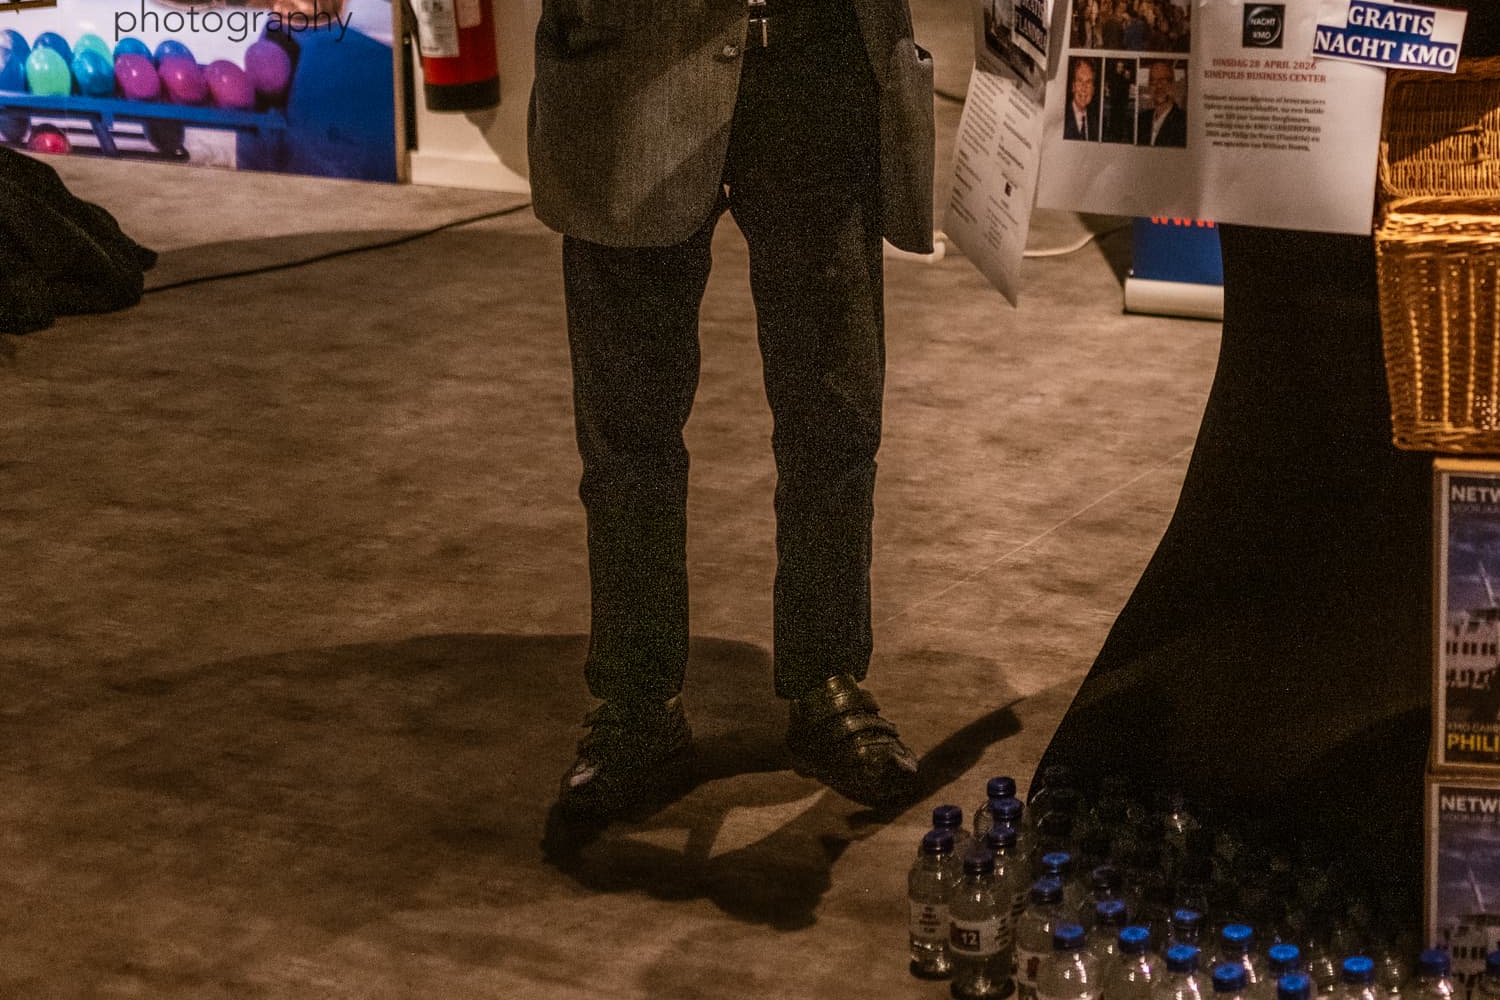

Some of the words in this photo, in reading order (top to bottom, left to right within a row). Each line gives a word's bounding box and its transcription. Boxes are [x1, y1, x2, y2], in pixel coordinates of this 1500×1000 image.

[1348, 5, 1434, 36] GRATIS
[1315, 30, 1397, 61] NACHT
[1399, 43, 1457, 67] KMO
